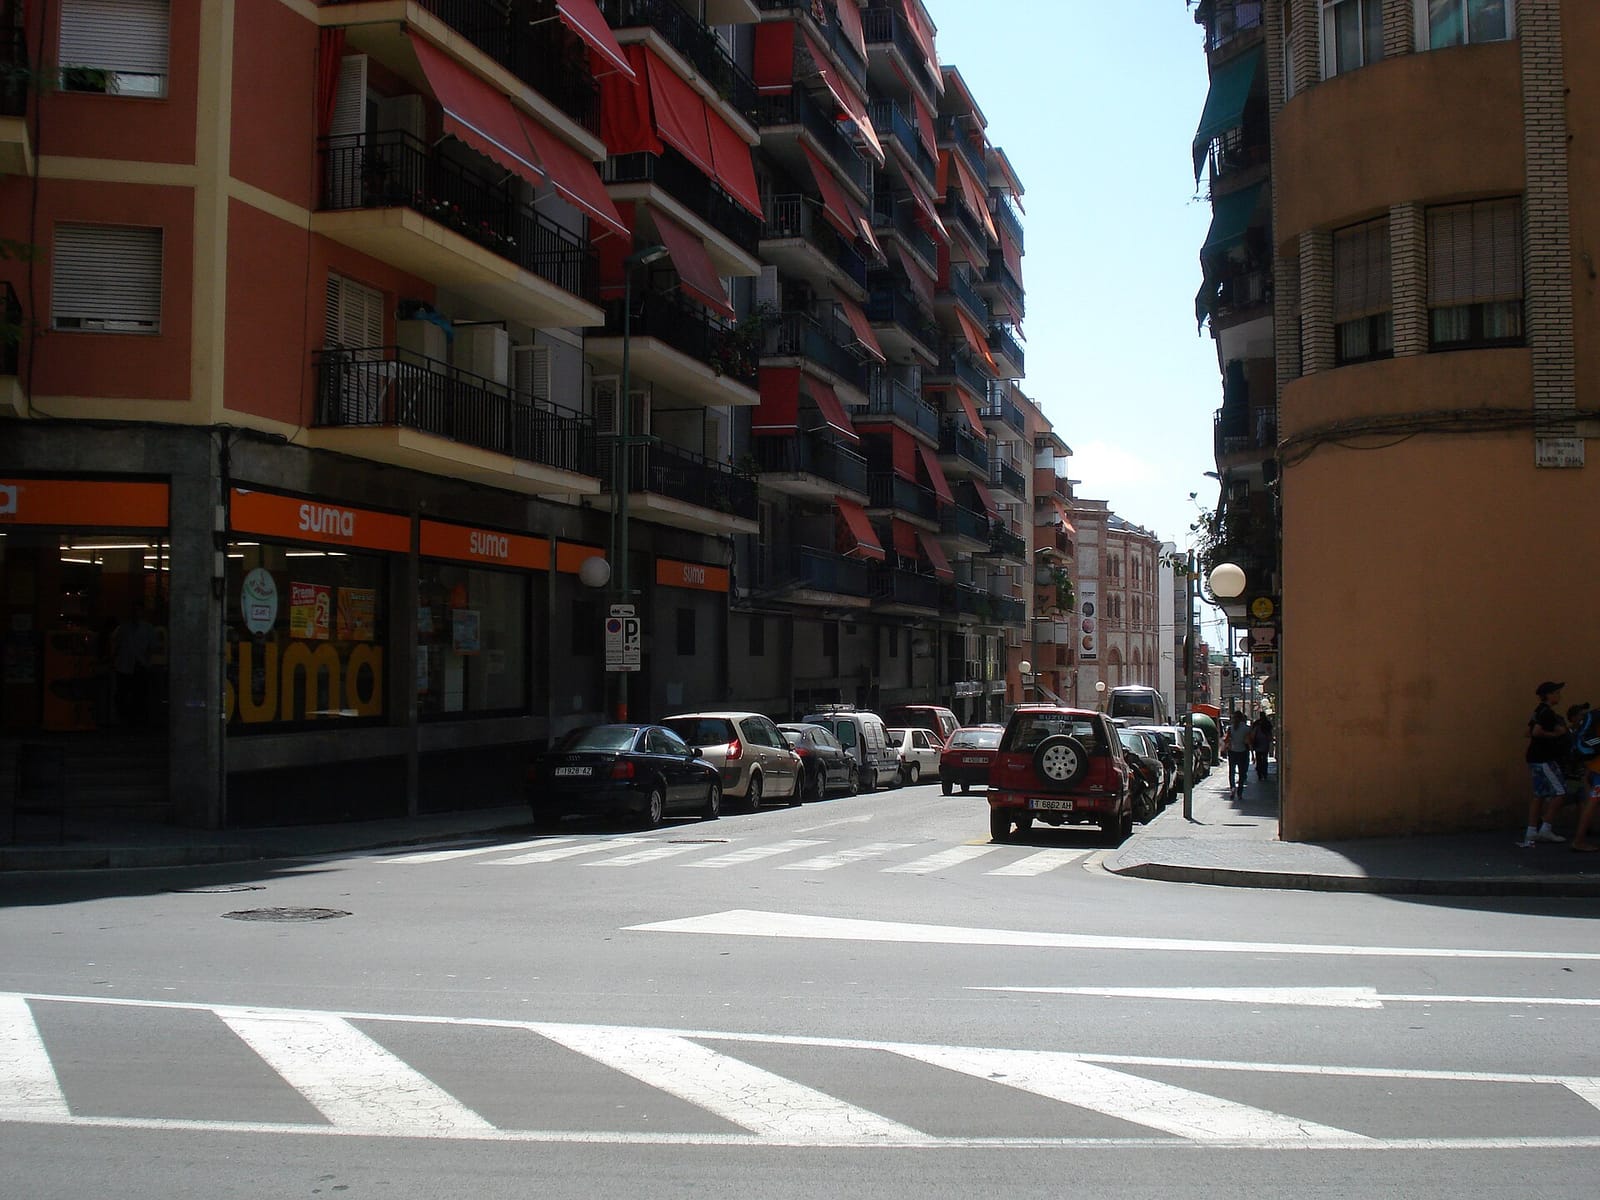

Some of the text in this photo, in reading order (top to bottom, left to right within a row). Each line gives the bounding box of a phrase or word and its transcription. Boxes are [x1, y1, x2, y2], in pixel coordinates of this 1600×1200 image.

[298, 504, 354, 536] suma
[470, 531, 508, 558] suma
[683, 564, 705, 585] suma
[625, 619, 638, 644] P
[226, 641, 384, 724] uma
